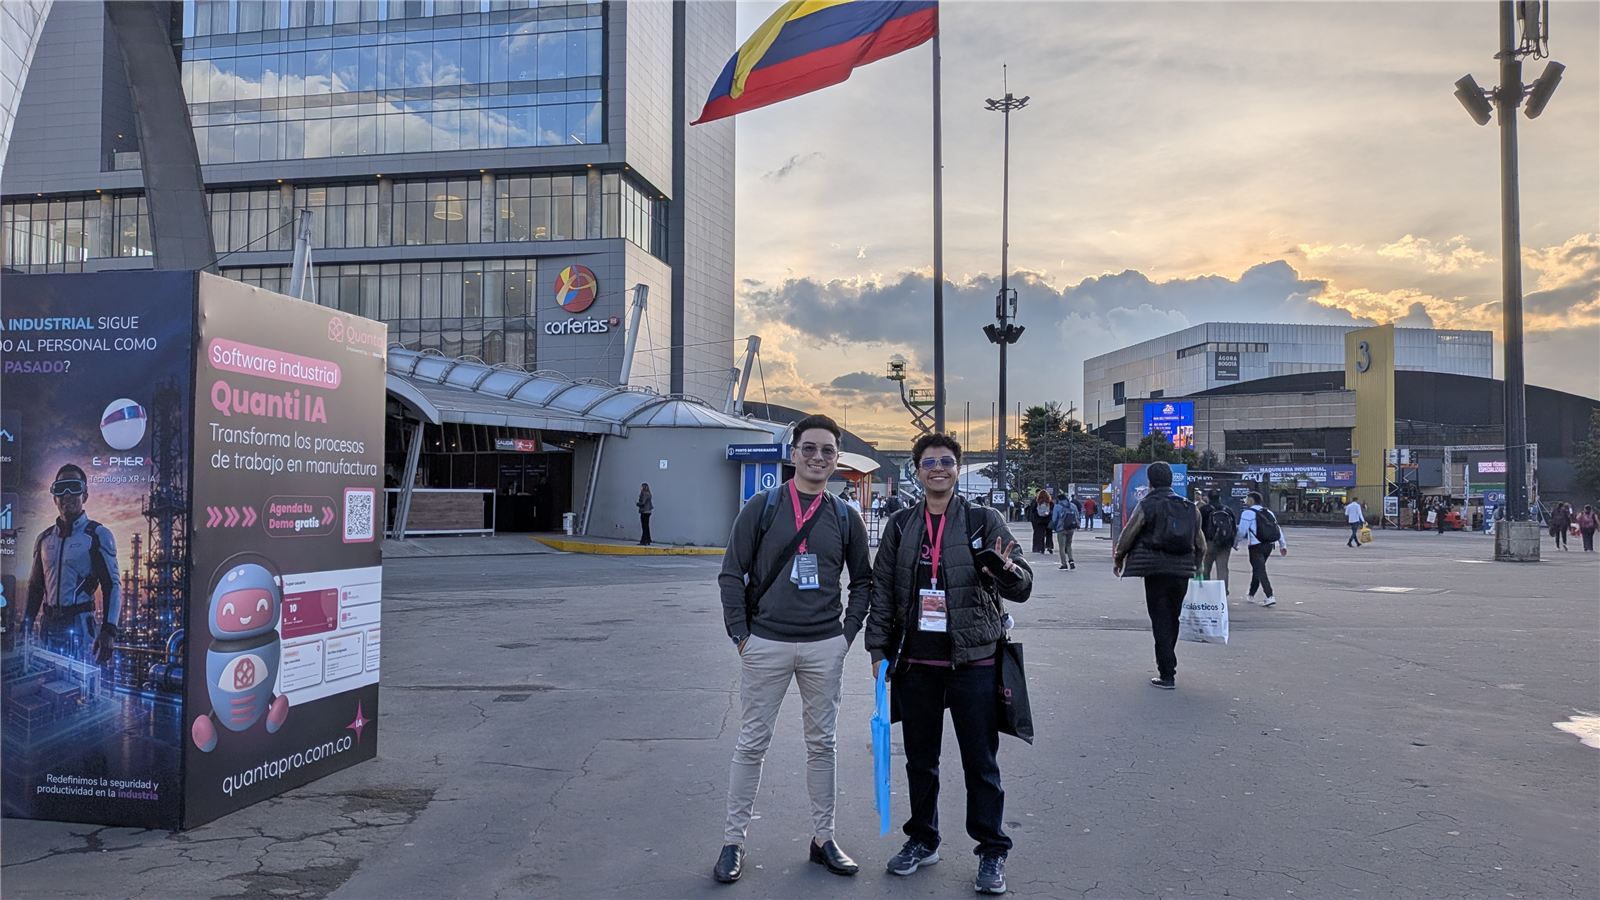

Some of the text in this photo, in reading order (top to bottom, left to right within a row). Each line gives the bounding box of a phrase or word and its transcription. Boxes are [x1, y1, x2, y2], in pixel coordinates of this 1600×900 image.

[9, 317, 94, 331] INDUSTRIAL
[98, 316, 139, 329] SIGUE
[544, 316, 608, 335] corferias
[16, 339, 34, 352] AL
[38, 338, 111, 351] PERSONAL
[114, 337, 157, 350] COMO
[1356, 341, 1372, 373] 3
[5, 360, 71, 373] PASADO?
[213, 345, 337, 385] Software industrial
[211, 380, 327, 424] Quanti IA
[209, 423, 364, 453] Transforma los procesos
[211, 450, 377, 476] de trabajo en manufactura
[90, 475, 127, 485] Tecnología
[269, 503, 312, 517] Agenda tu
[269, 517, 319, 532] Demo gratis
[290, 603, 297, 613] 10
[356, 719, 363, 728] IA
[222, 736, 351, 797] quantapro.com.co
[46, 773, 159, 791] Redefinimos la seguridad y
[37, 785, 159, 800] productividad en la industria
